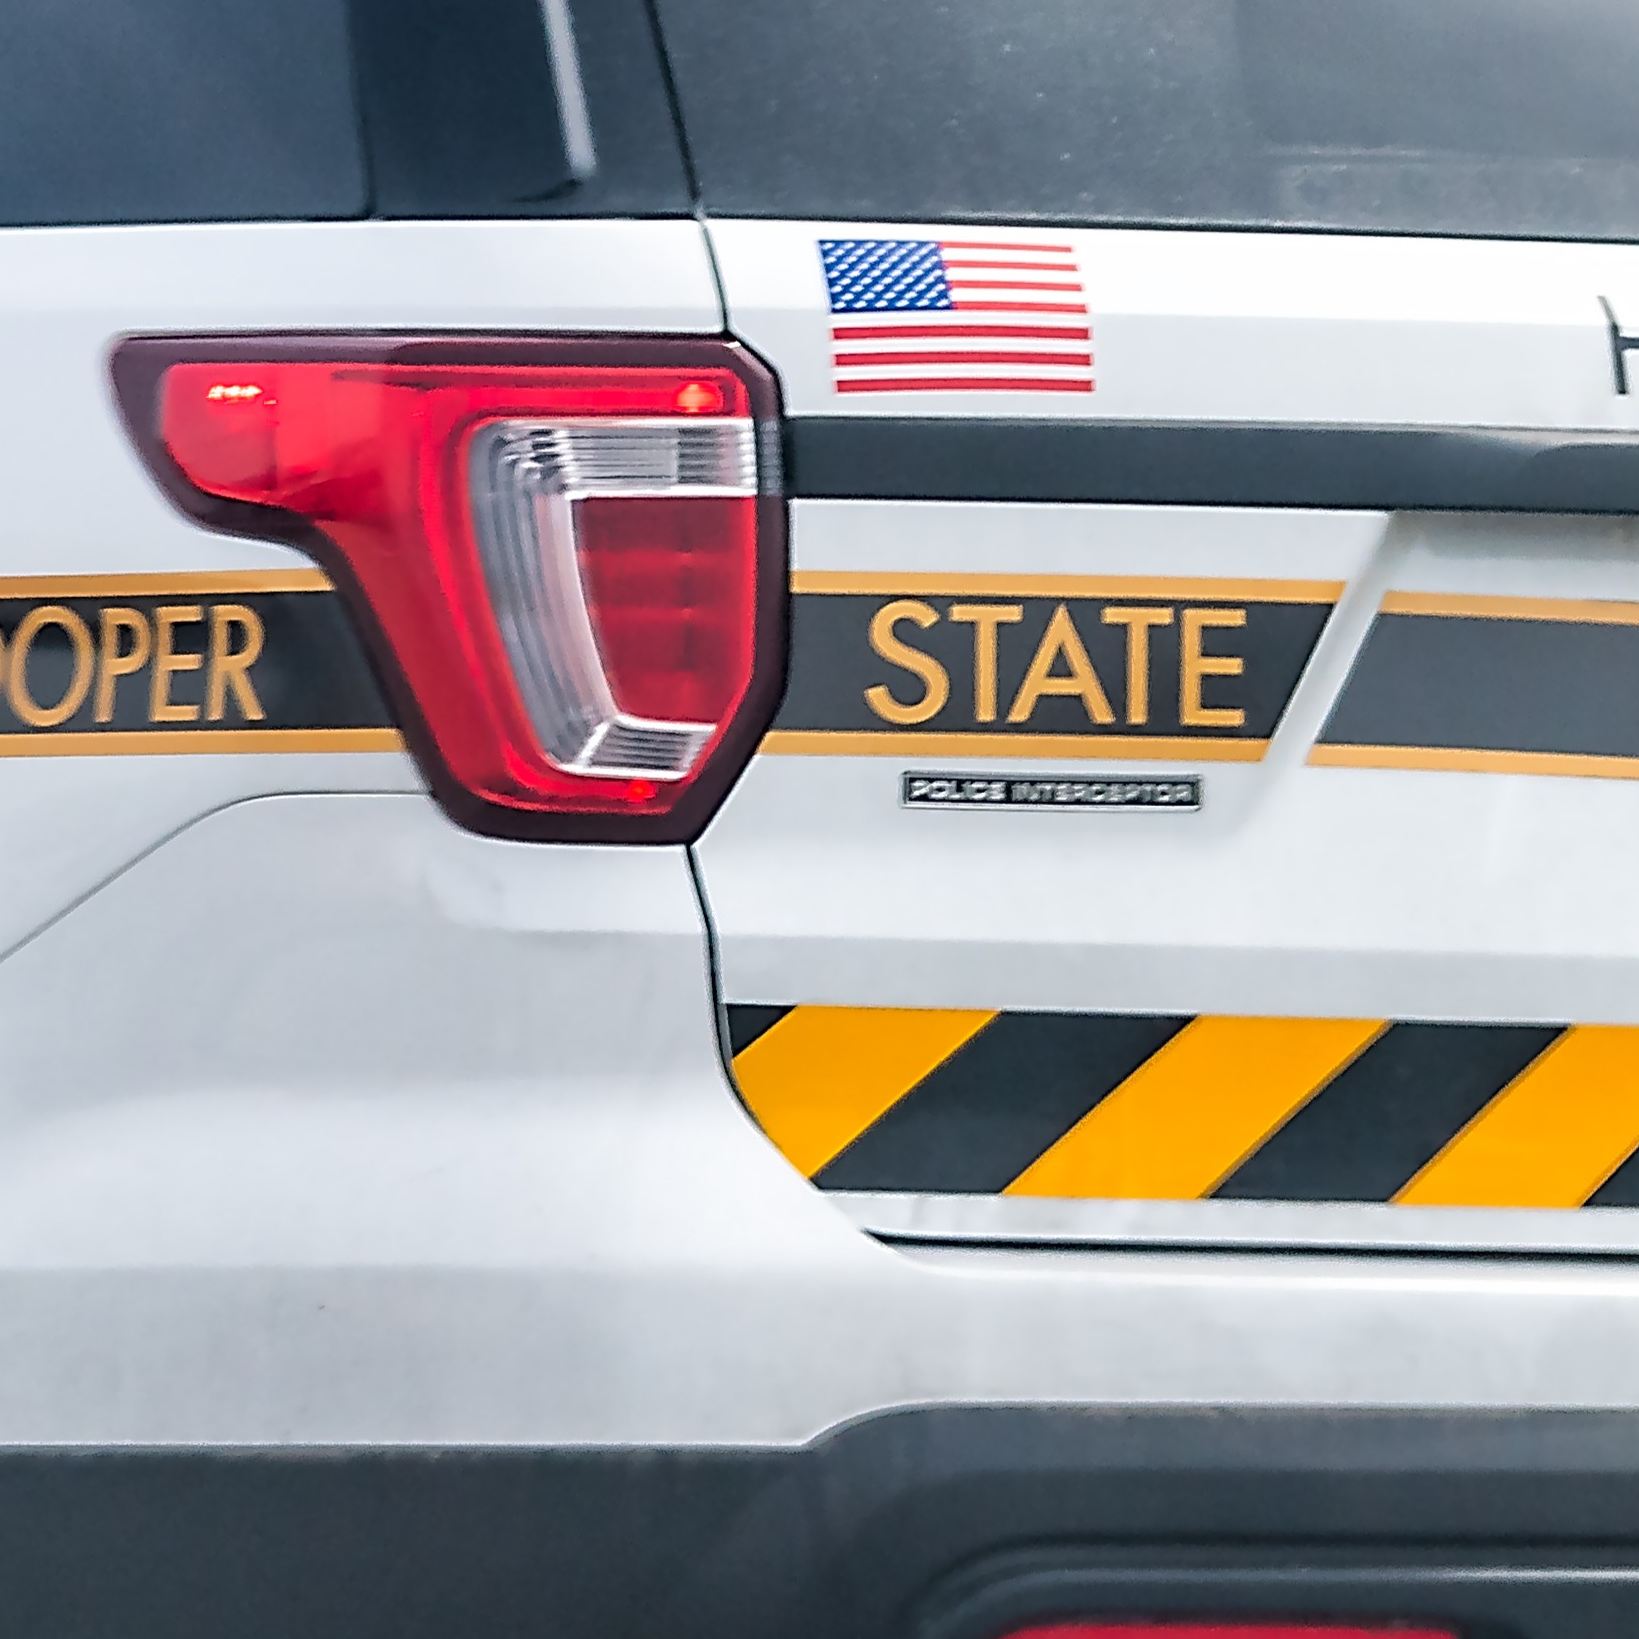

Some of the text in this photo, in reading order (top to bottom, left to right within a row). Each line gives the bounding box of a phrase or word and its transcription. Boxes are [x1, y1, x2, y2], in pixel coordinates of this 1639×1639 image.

[864, 598, 1248, 728] STATE
[911, 778, 1193, 805] POLICE INTERCEPTOR
